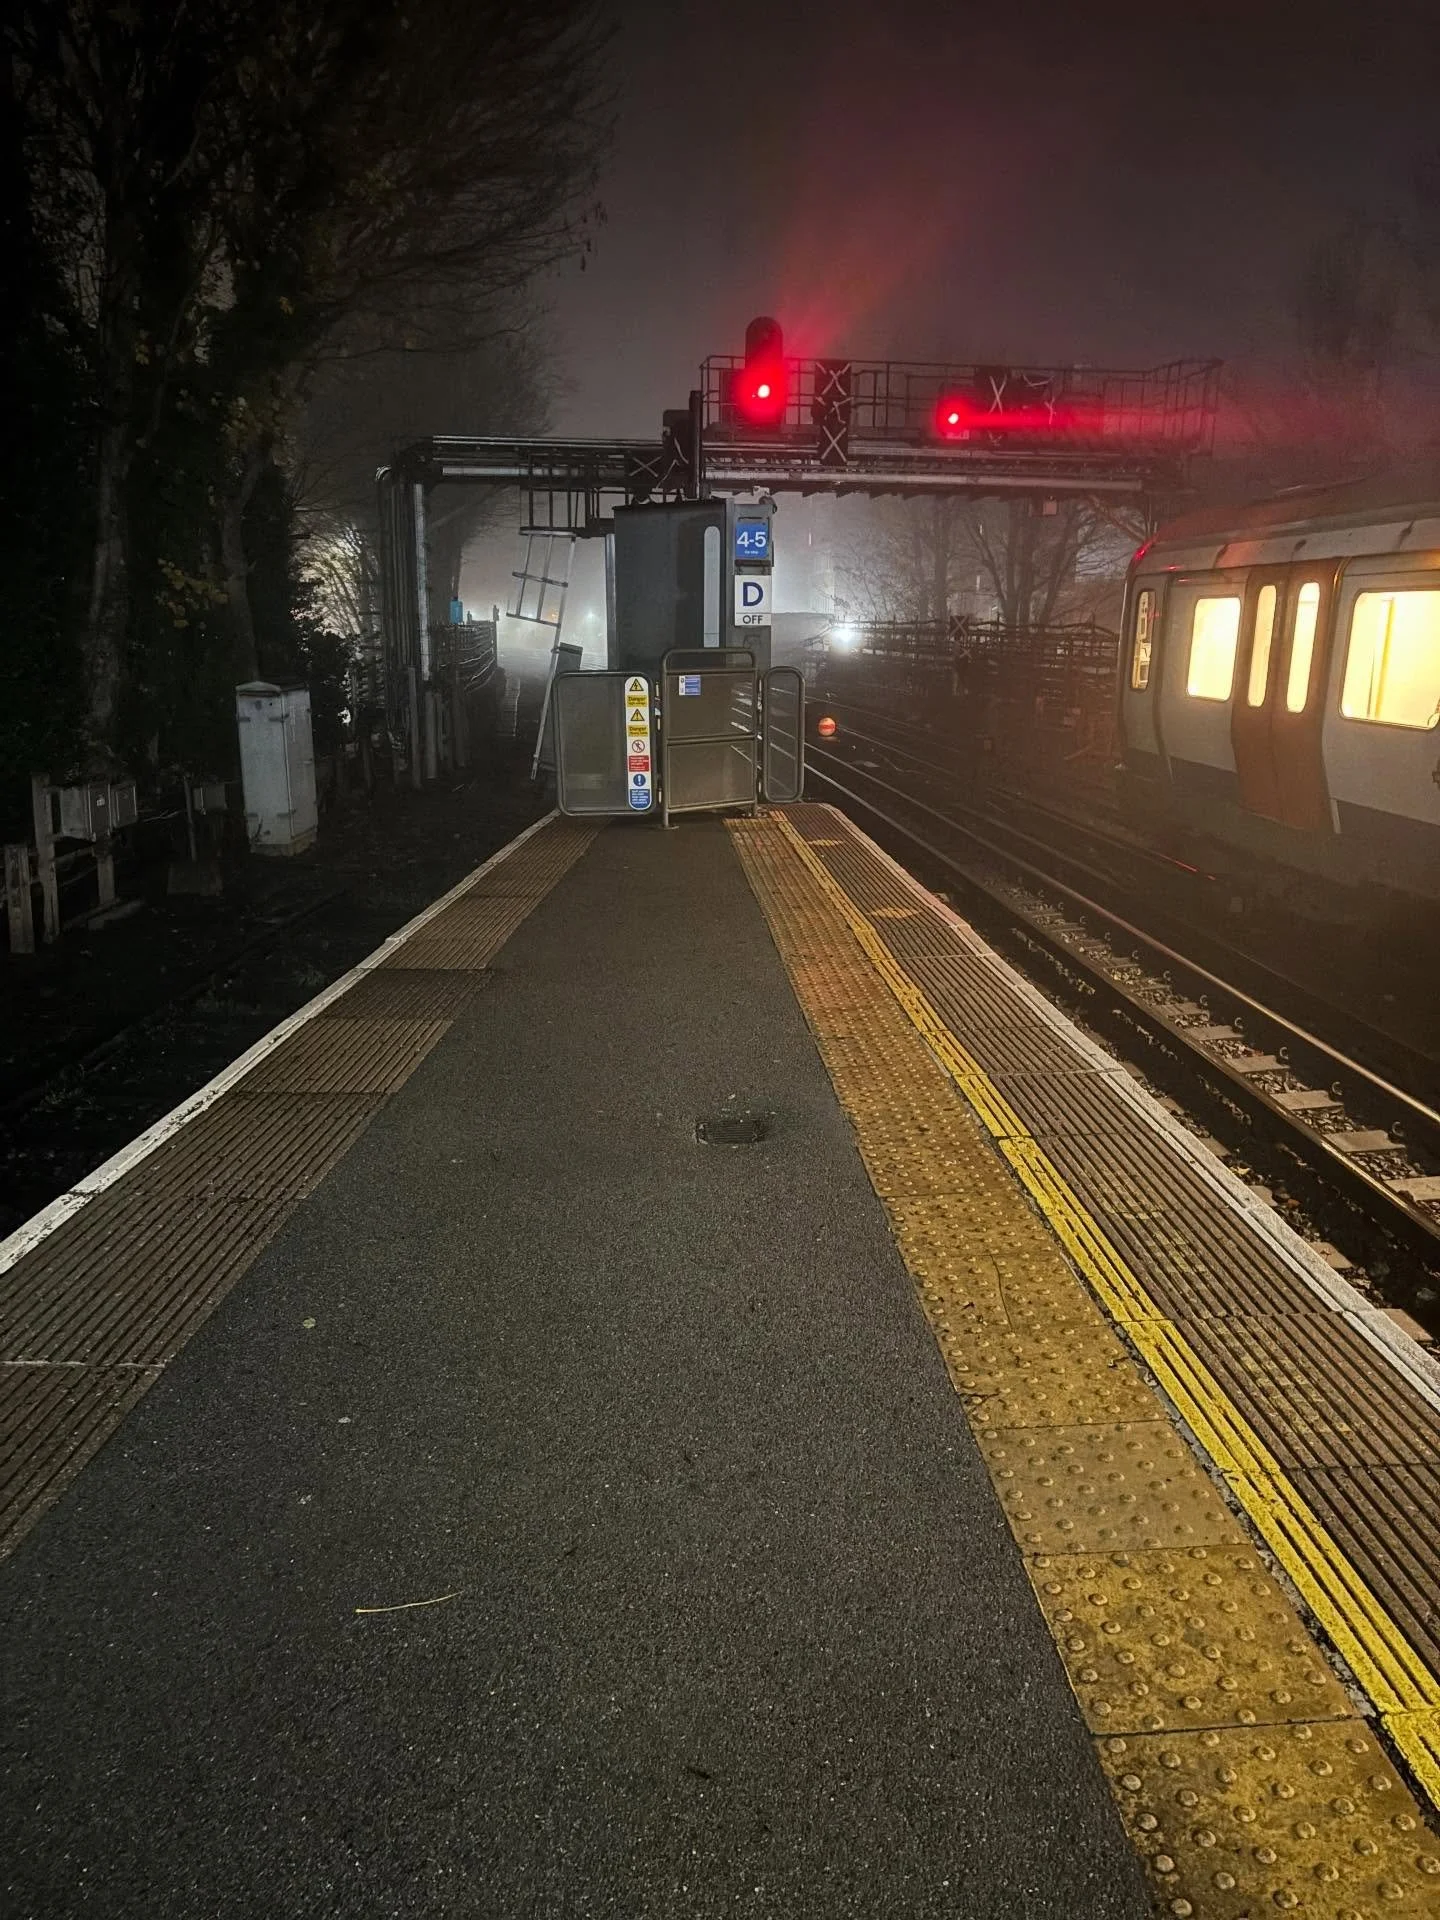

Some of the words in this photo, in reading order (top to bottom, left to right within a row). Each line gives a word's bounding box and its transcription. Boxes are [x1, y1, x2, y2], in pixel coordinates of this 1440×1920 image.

[736, 531, 767, 548] 4-5
[742, 581, 764, 607] D
[742, 615, 763, 624] OFF
